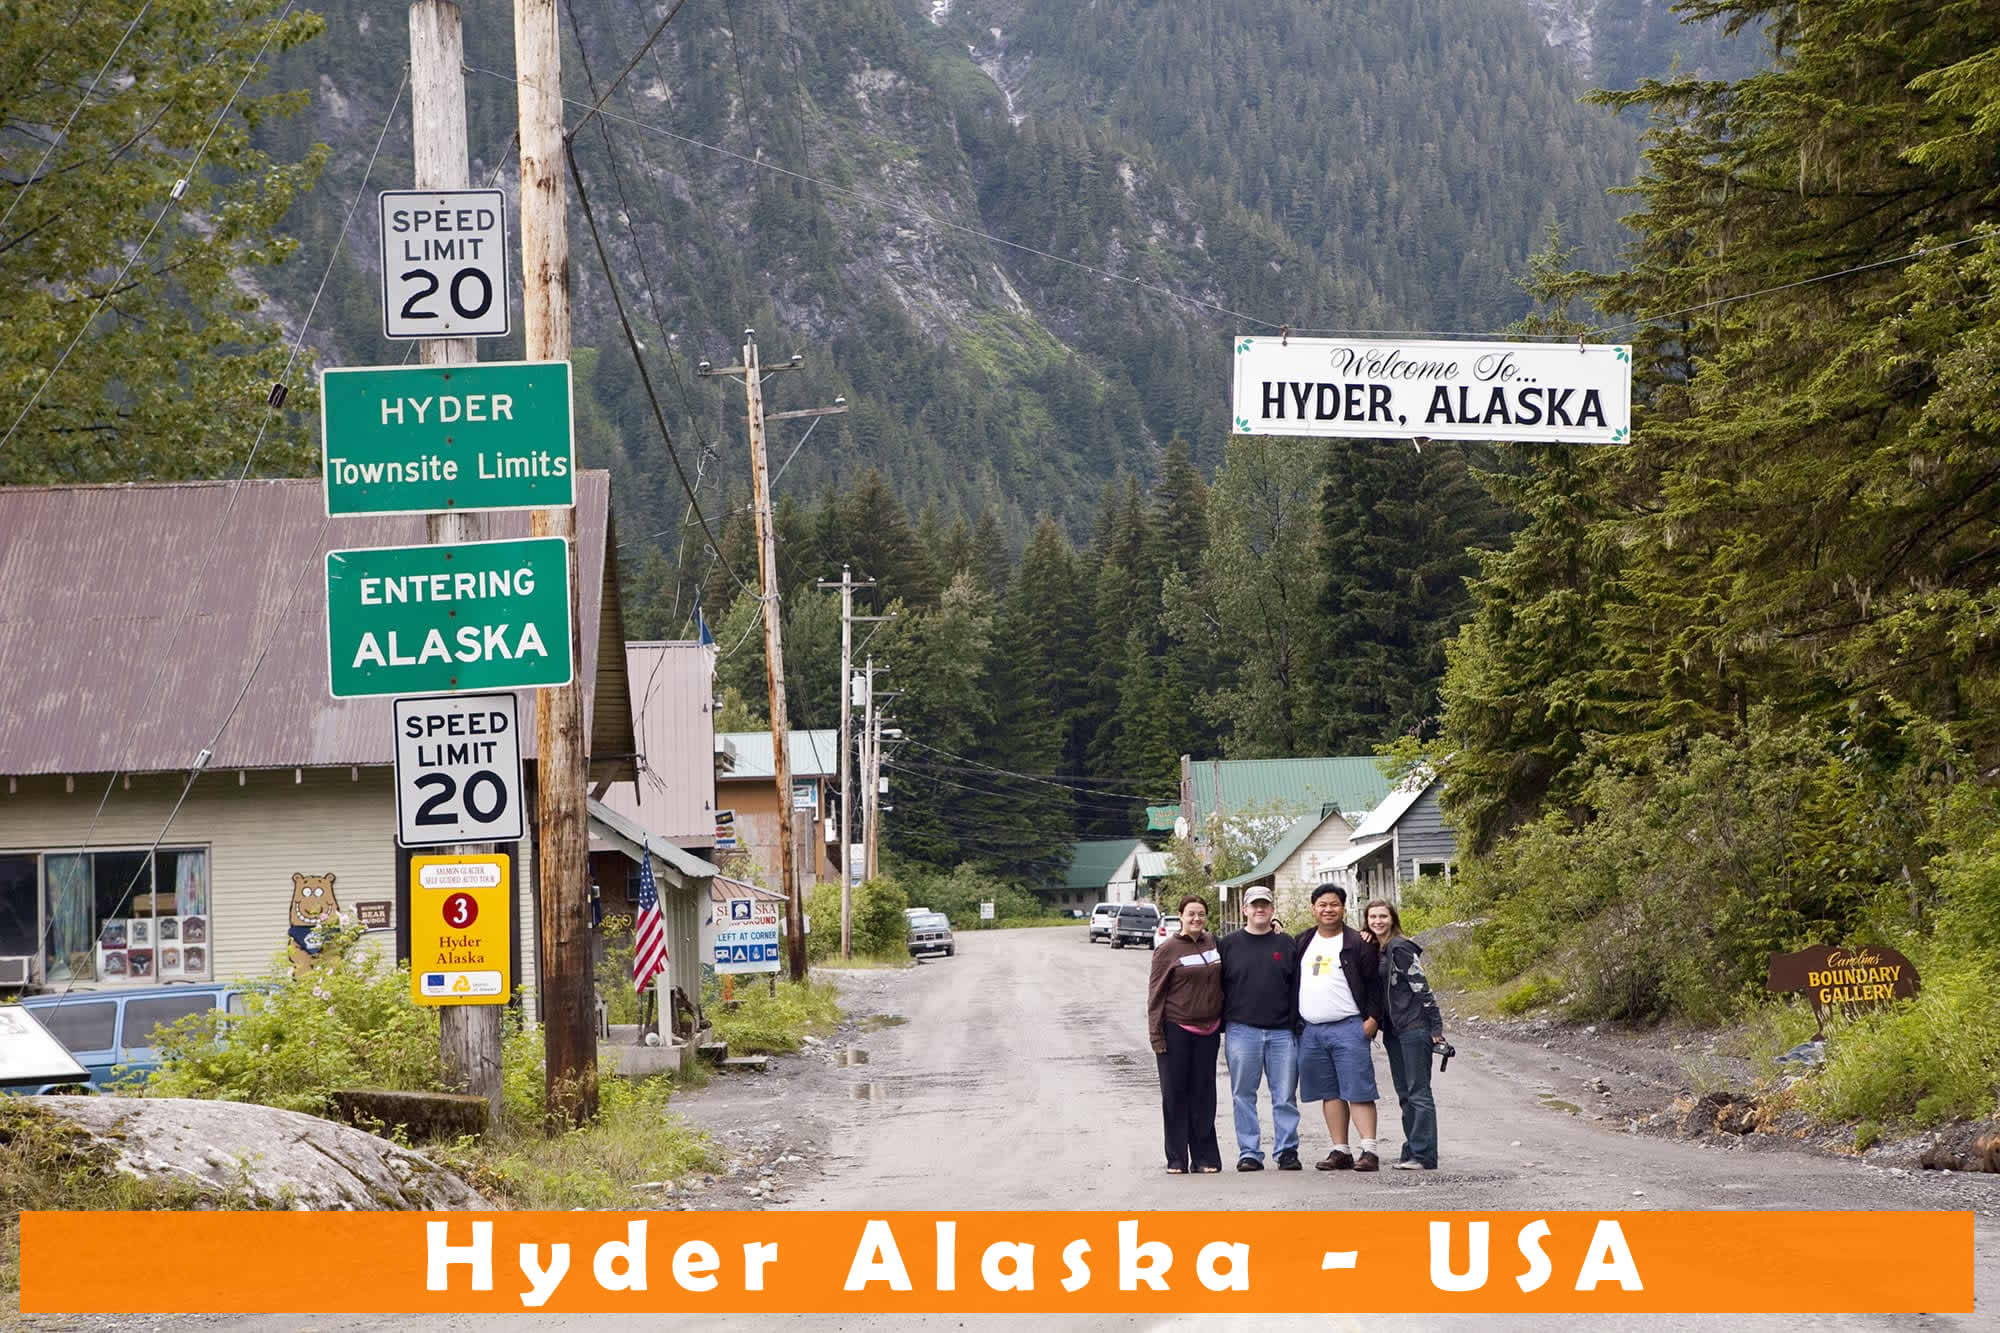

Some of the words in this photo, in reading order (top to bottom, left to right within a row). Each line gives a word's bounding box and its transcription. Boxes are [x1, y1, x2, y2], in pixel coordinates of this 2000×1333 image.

[392, 209, 495, 233] SPEED
[404, 238, 484, 262] LIMIT
[400, 267, 493, 320] 20
[1330, 347, 1460, 380] Welcome
[381, 393, 514, 425] HYDER
[1261, 381, 1407, 427] HYDER,
[1424, 385, 1608, 427] ALASKA
[330, 454, 459, 485] Townsite
[478, 450, 568, 480] Limits
[360, 567, 535, 606] ENTERING
[351, 622, 549, 668] ALASKA
[405, 711, 508, 738] SPEED
[418, 741, 498, 767] LIMIT
[414, 770, 508, 826] 20
[453, 898, 468, 924] 3
[439, 936, 482, 951] Hyder
[718, 932, 737, 942] LEFT
[739, 931, 749, 941] AT
[750, 930, 777, 941] CORNER
[436, 952, 485, 965] Alaska
[1808, 965, 1902, 988] BOUNDARY
[1819, 983, 1895, 1005] GALLERY
